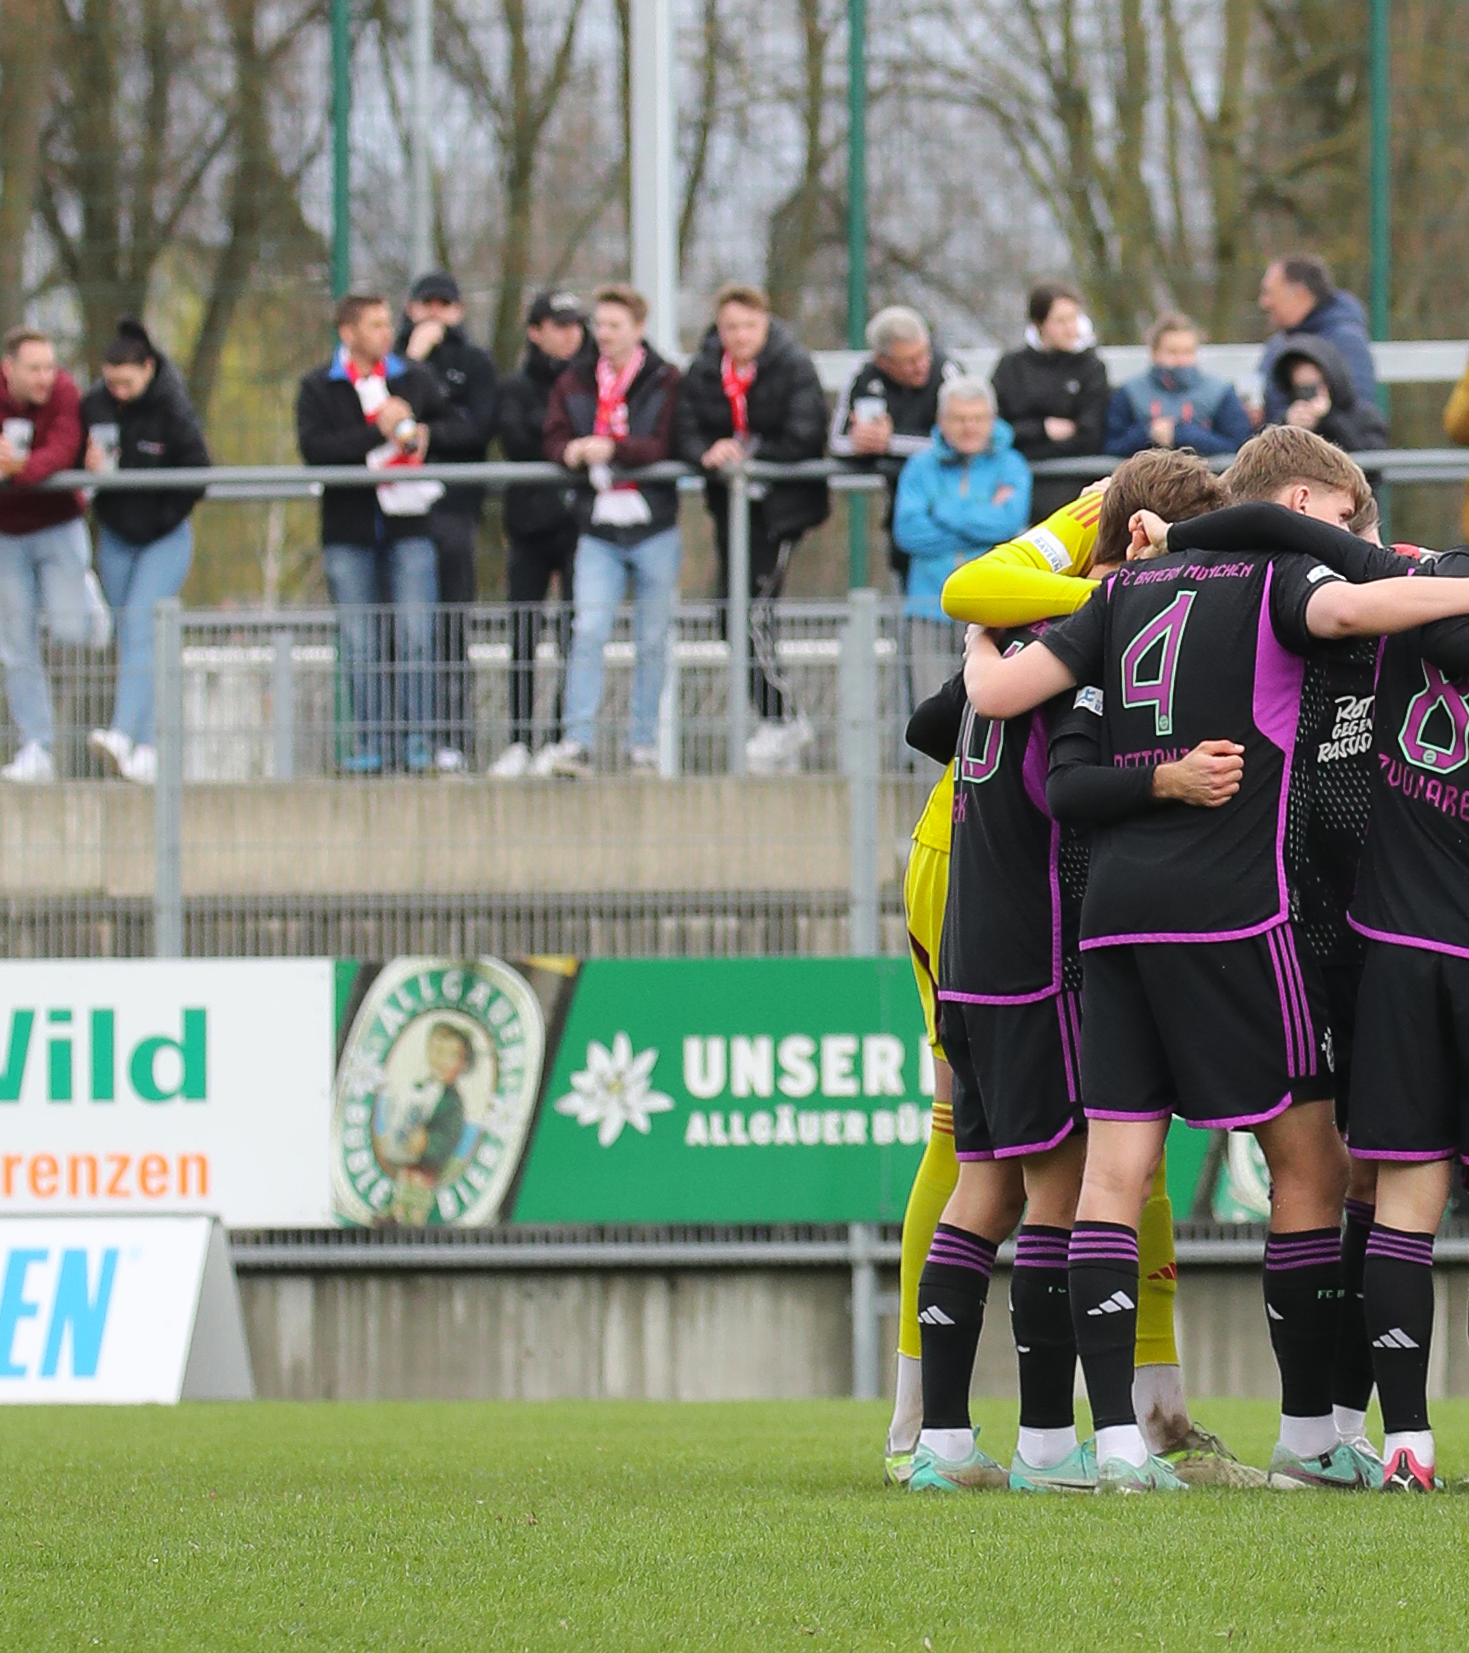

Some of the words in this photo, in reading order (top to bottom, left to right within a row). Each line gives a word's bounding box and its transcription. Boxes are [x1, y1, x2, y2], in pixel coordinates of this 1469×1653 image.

[1133, 564, 1182, 586] BAYERN
[1121, 590, 1197, 736] 4
[1334, 695, 1376, 723] ROT
[683, 1033, 905, 1098] UNSER
[684, 1103, 868, 1146] ALLGÄUER
[2, 1152, 209, 1198] renzen
